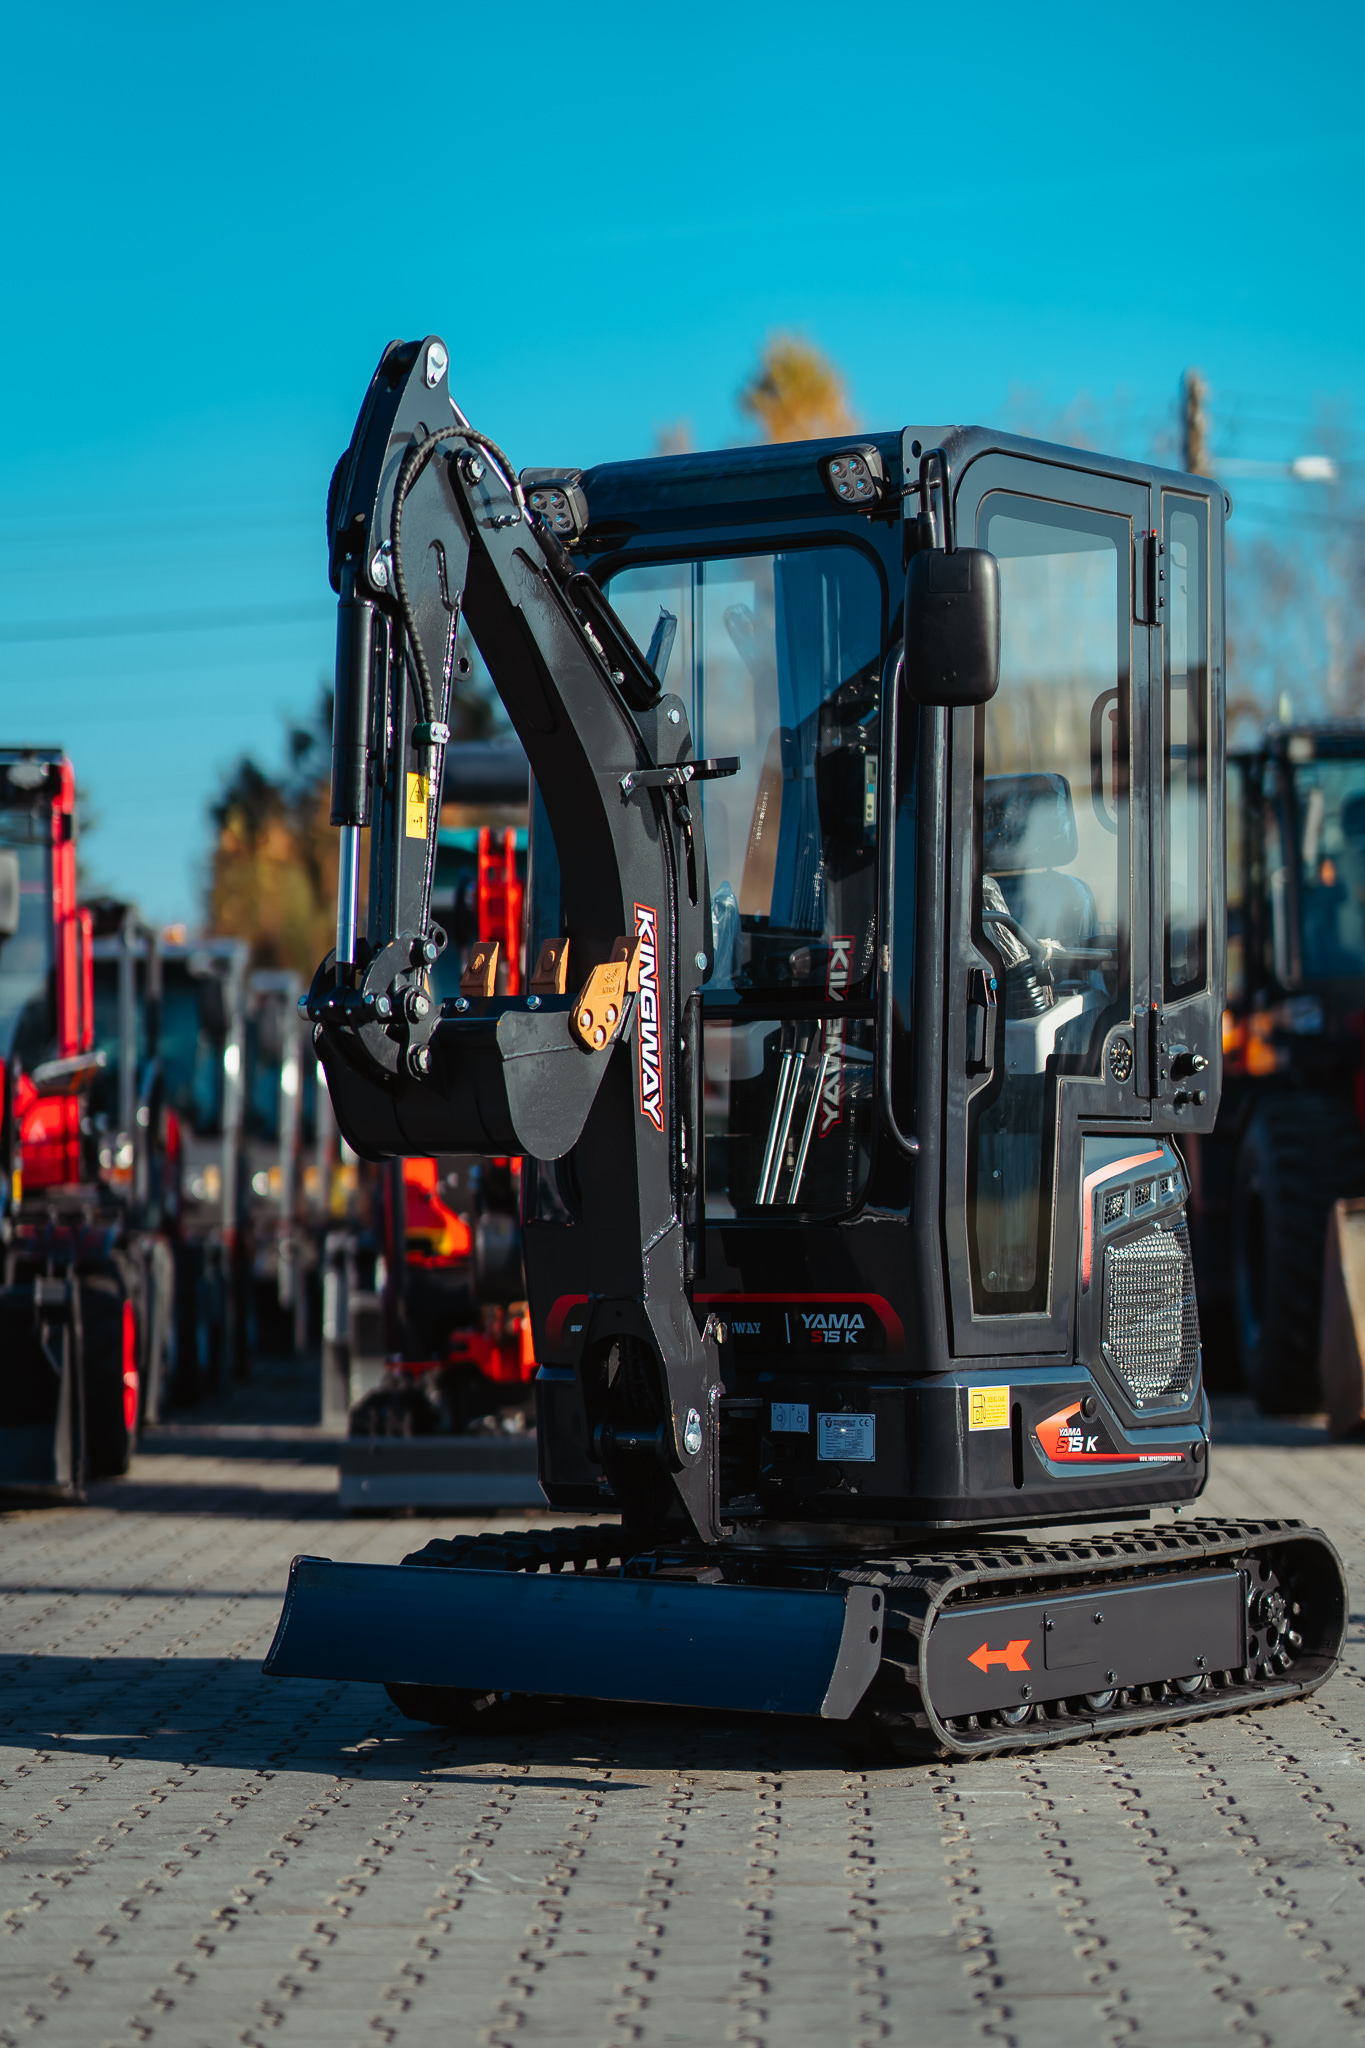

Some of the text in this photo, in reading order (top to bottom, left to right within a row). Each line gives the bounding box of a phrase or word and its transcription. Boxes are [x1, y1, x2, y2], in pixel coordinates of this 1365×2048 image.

[637, 908, 662, 1127] KINGWAY
[801, 1313, 866, 1329] YAMA
[811, 1330, 858, 1343] S15 K
[1058, 1427, 1082, 1437] YAMA
[1056, 1436, 1099, 1453] S15 K
